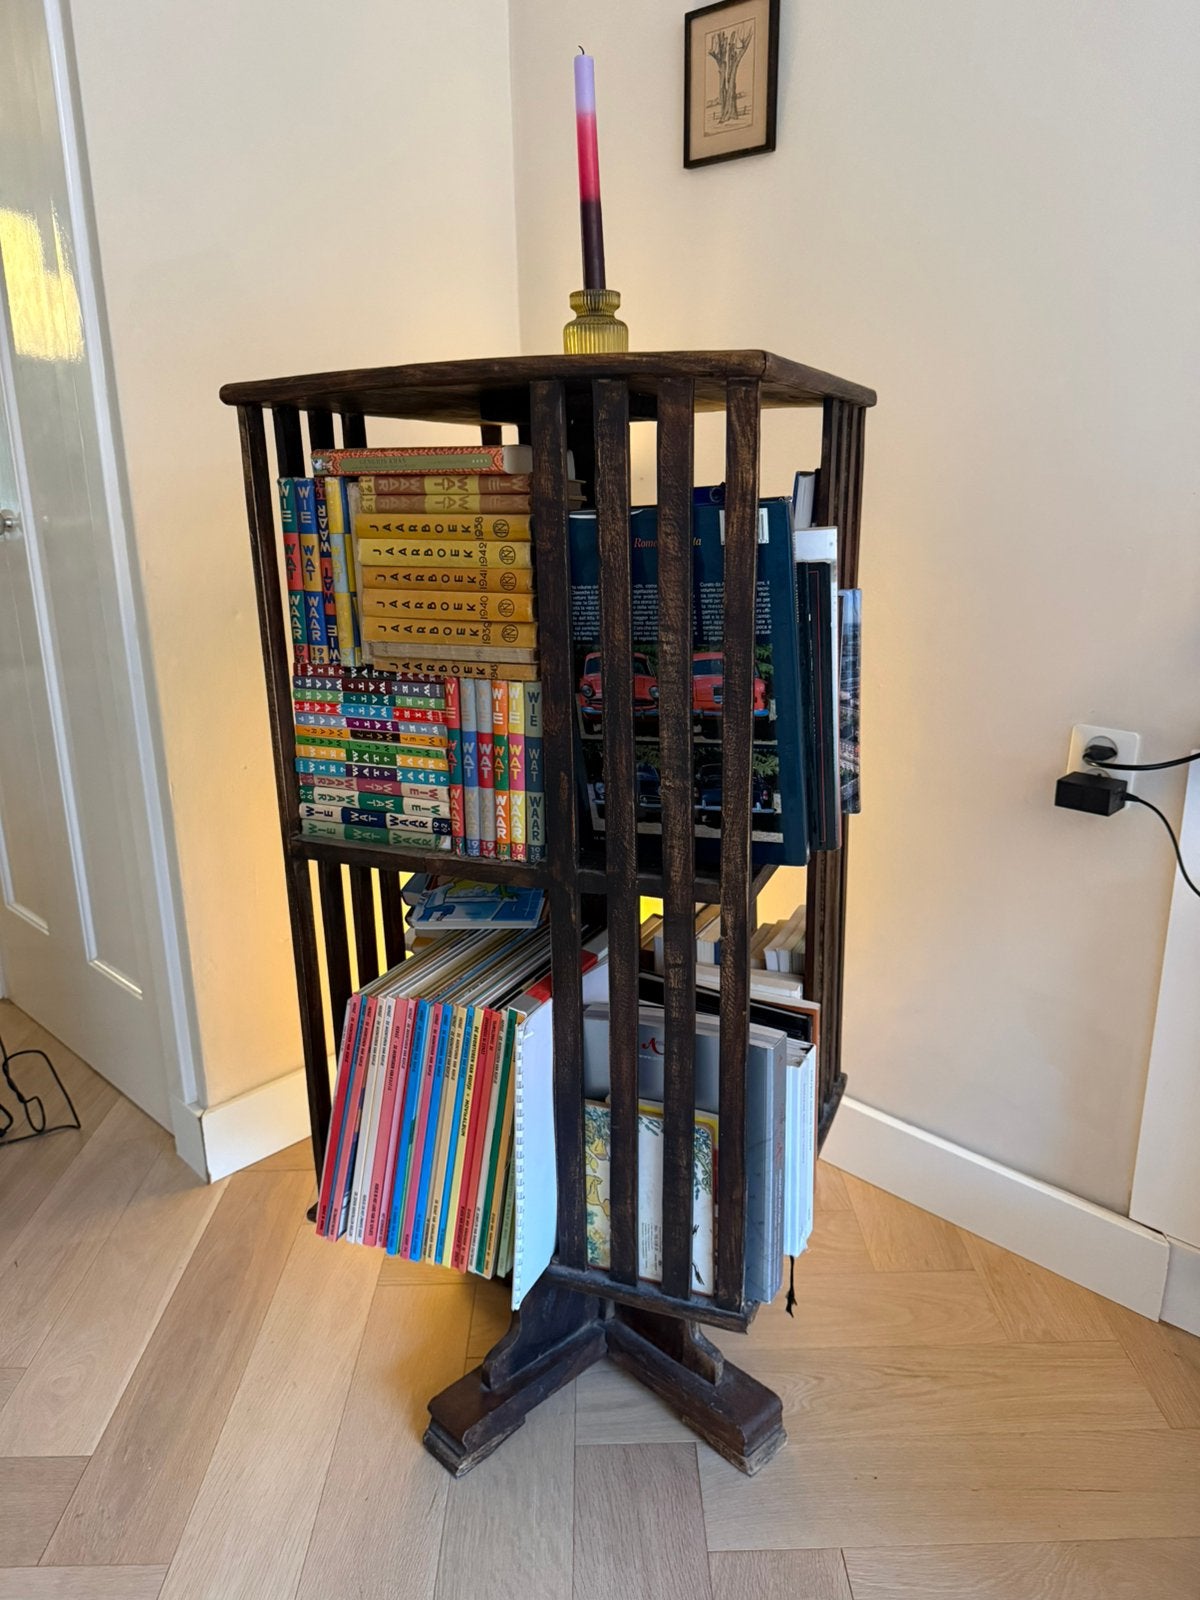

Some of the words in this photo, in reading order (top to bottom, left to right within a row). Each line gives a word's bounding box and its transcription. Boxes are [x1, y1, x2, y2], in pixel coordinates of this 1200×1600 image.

[378, 478, 421, 493] WAAR
[433, 476, 469, 492] WAT
[279, 485, 292, 522] WIE
[297, 486, 312, 524] WIE
[434, 495, 469, 510] WAT
[317, 504, 331, 552] WAAR
[369, 522, 474, 534] JAARBOEK
[474, 516, 484, 540] 1938
[286, 544, 296, 580] WAT
[302, 545, 316, 581] WAT
[372, 547, 474, 559] JAARBOEK
[478, 542, 488, 566] 1942
[323, 567, 335, 604] WAT
[378, 573, 477, 584] JAARBOEK
[478, 569, 488, 590] 1941
[289, 595, 302, 640] WAAR
[307, 596, 321, 641] WAAR
[376, 600, 477, 612] JAARBOEK
[480, 595, 489, 620] 1940
[327, 624, 341, 660] WIE
[377, 624, 480, 637] JAARBOEK
[481, 621, 493, 644] 1939
[388, 662, 486, 676] JAARBOEK
[492, 688, 503, 725] WIE
[508, 687, 521, 724] WIE
[527, 691, 540, 727] WIE
[448, 740, 457, 774] WAT
[463, 742, 475, 778] WAT
[479, 743, 492, 779] WAT
[494, 746, 505, 781] WAT
[509, 744, 522, 780] WAT
[528, 748, 540, 782] WAT
[317, 777, 356, 790] WAAR
[318, 793, 357, 806] WAAR
[365, 783, 393, 795] WAT
[409, 787, 439, 800] WIE
[305, 805, 334, 818] WIE
[350, 811, 378, 823] WAT
[389, 814, 429, 829] WAAR
[366, 799, 395, 811] WAT
[411, 804, 442, 816] WIE
[450, 788, 460, 831] WAAR
[495, 795, 507, 840] WAAR
[511, 794, 523, 839] WAAR
[529, 795, 542, 842] WAAR
[308, 823, 336, 835] WIE
[353, 828, 381, 840] WAT
[392, 833, 432, 846] WAAR
